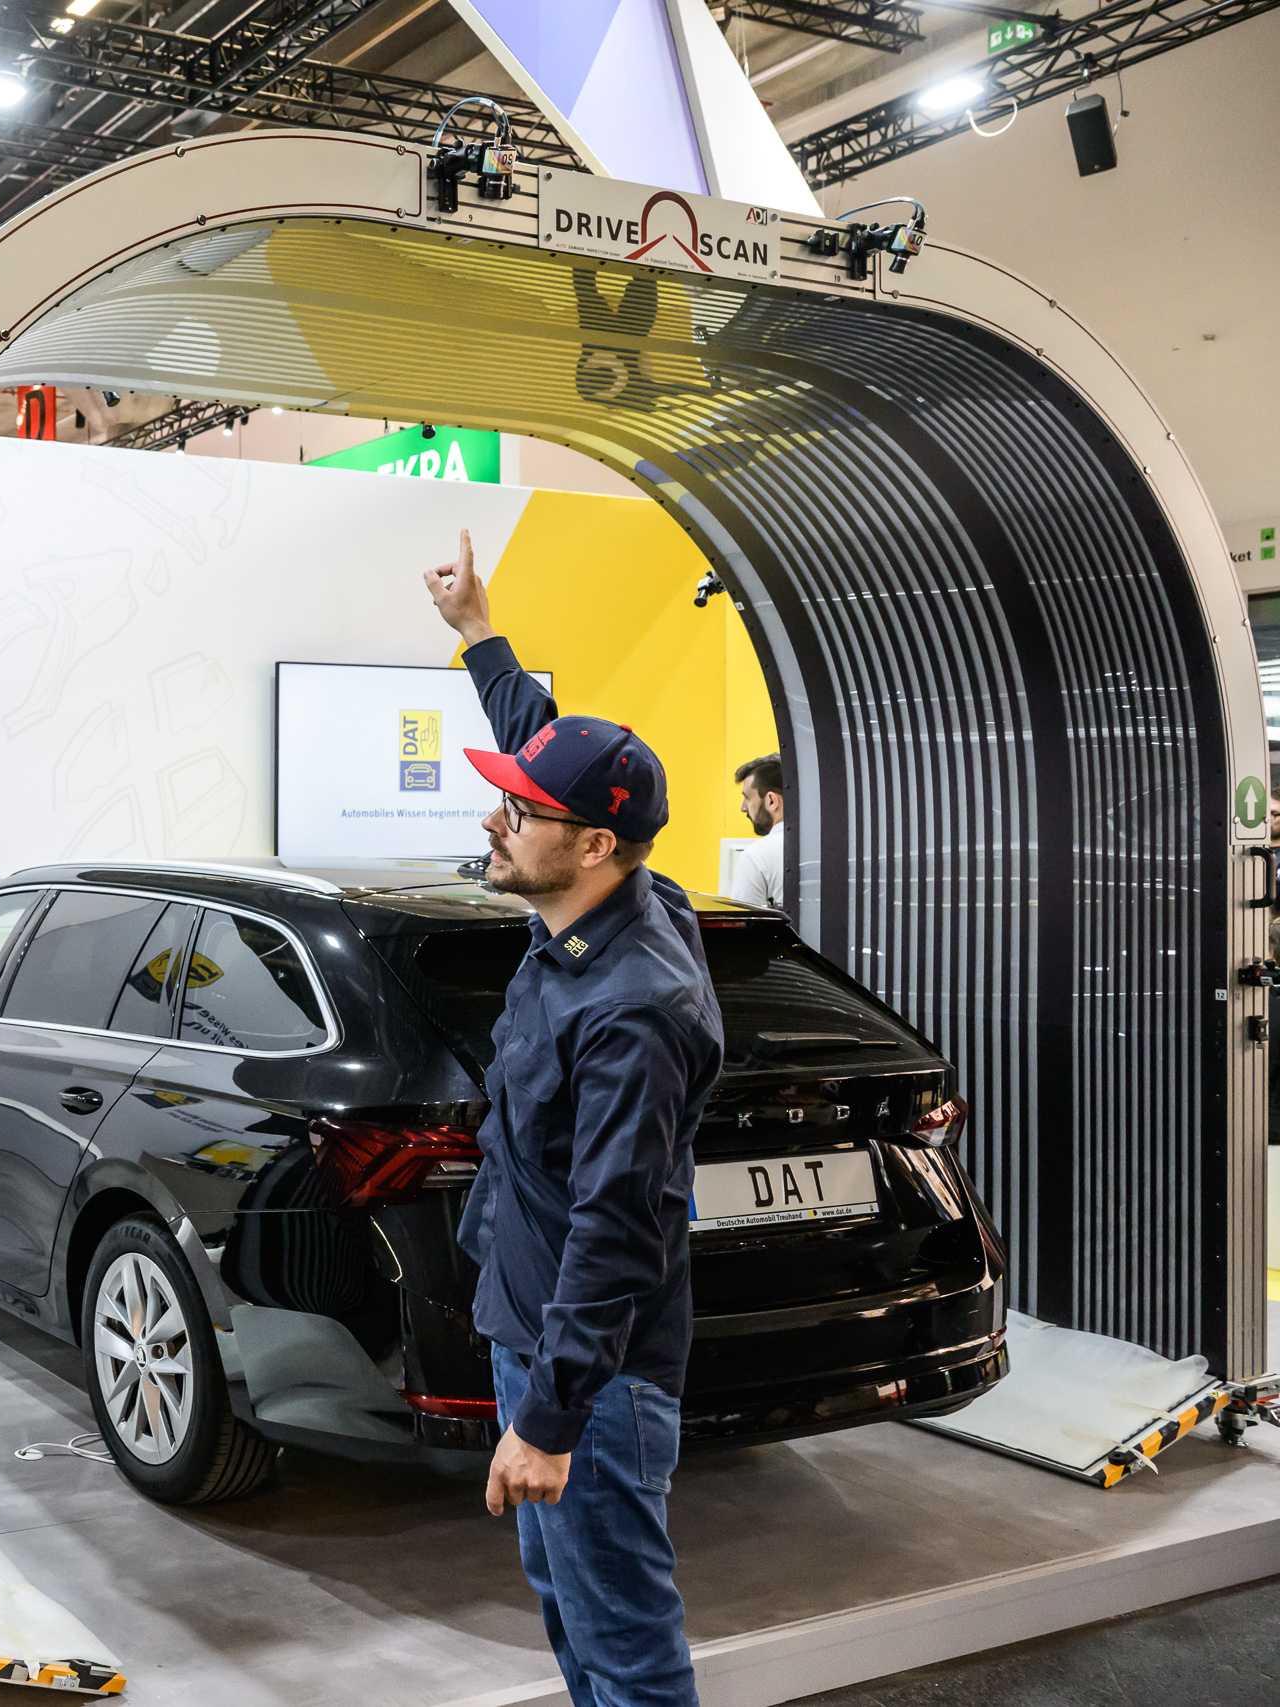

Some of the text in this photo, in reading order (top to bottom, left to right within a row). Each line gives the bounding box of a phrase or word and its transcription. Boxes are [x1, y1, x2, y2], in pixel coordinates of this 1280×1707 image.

[745, 206, 768, 226] ADI
[555, 208, 768, 266] DRIVE SCAN
[912, 233, 923, 246] 10
[402, 715, 419, 756] DAT
[341, 808, 395, 818] Automobiles
[397, 808, 427, 818] Wissen
[428, 808, 460, 820] beginnt
[462, 808, 475, 818] mit
[747, 1160, 824, 1208] DAT
[716, 1207, 852, 1228] Deutsche Automobil Treuhand www.dat.de
